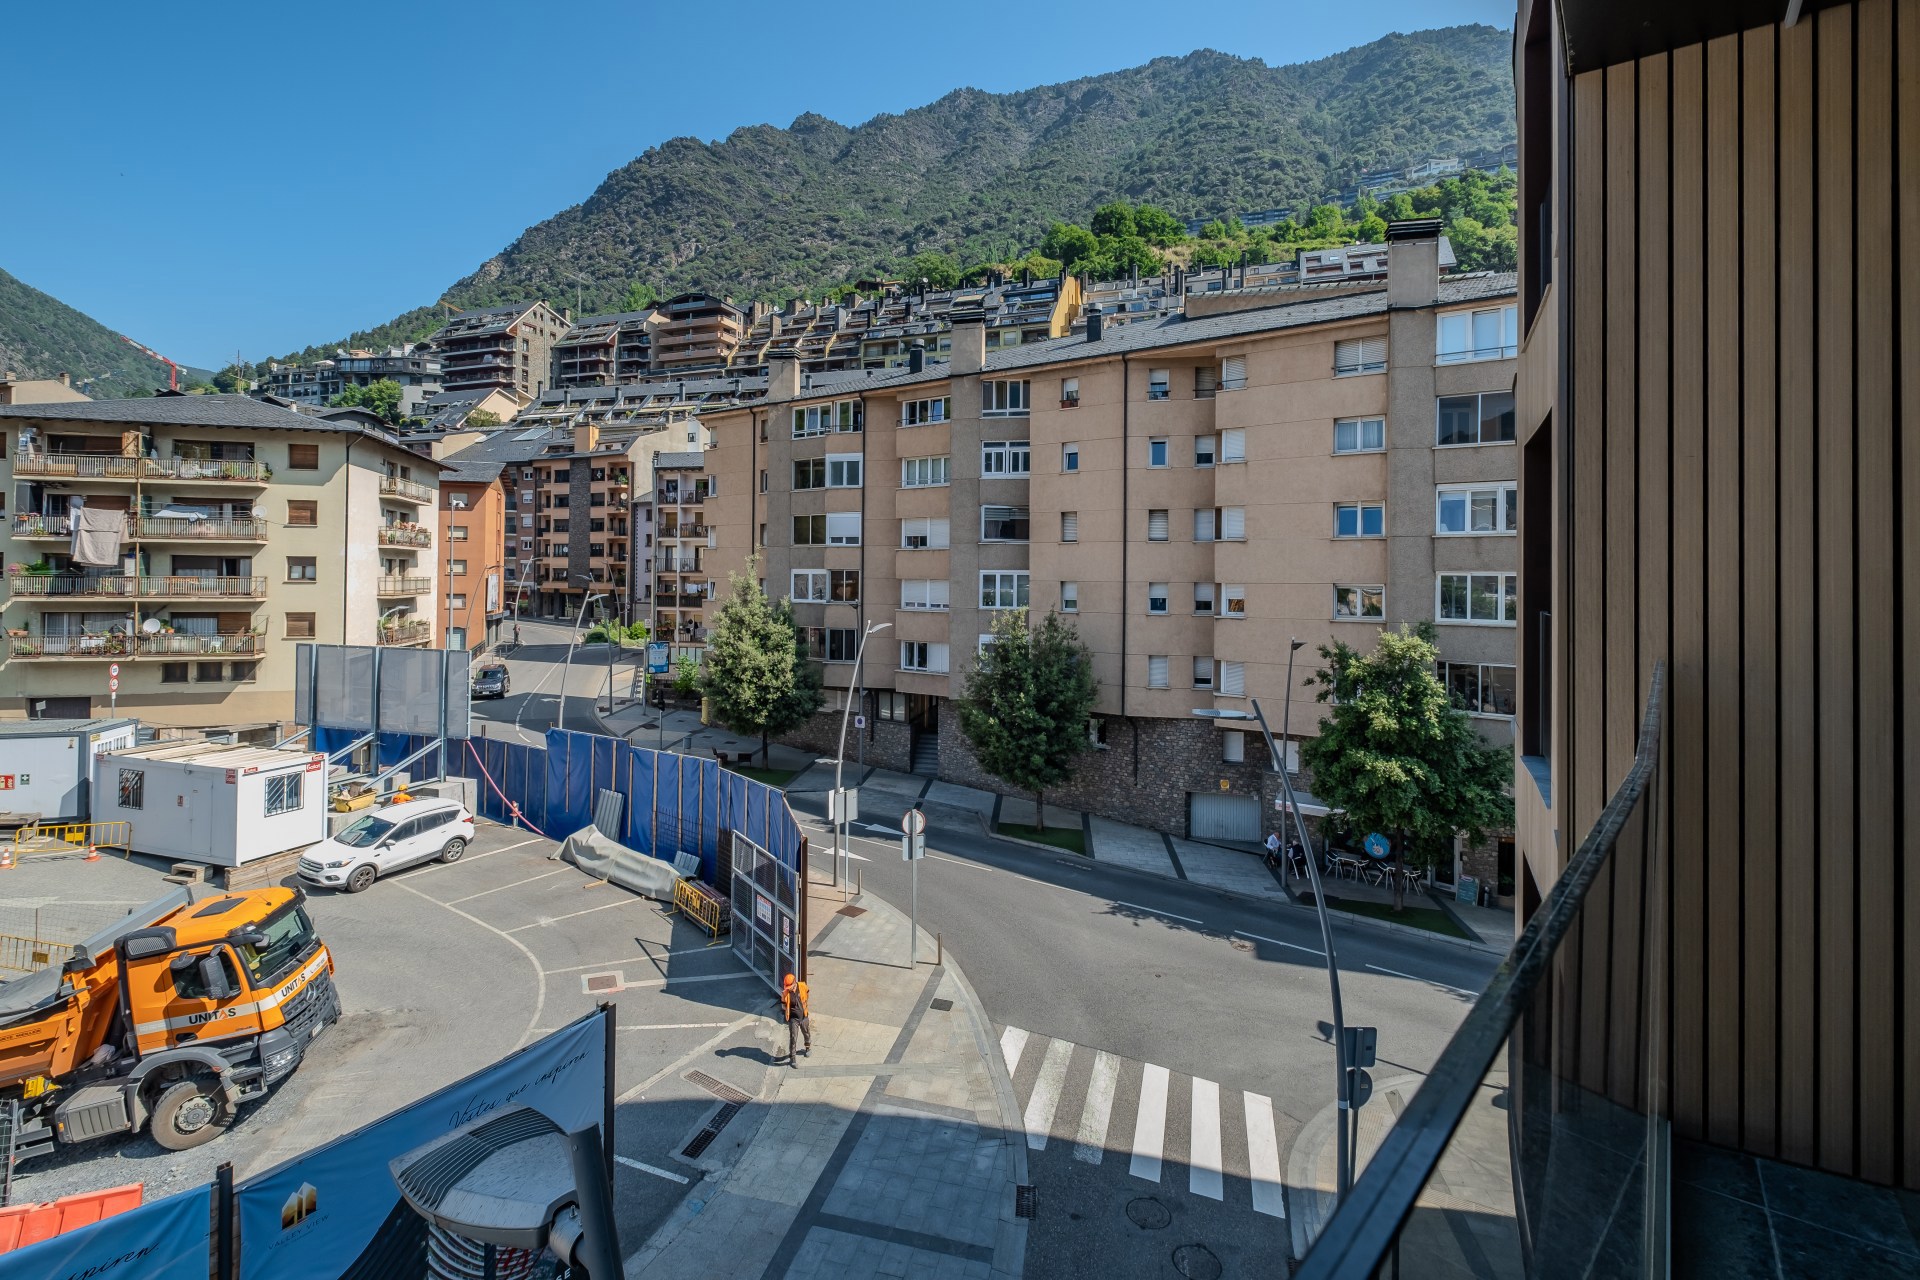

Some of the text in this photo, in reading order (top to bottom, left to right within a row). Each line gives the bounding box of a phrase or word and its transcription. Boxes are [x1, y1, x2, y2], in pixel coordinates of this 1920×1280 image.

[281, 973, 306, 997] UNITAS
[189, 1008, 236, 1025] UNITAS
[448, 1050, 590, 1129] Vistes que inspiren
[268, 1229, 302, 1250] VALLEY
[305, 1213, 330, 1230] VIEW
